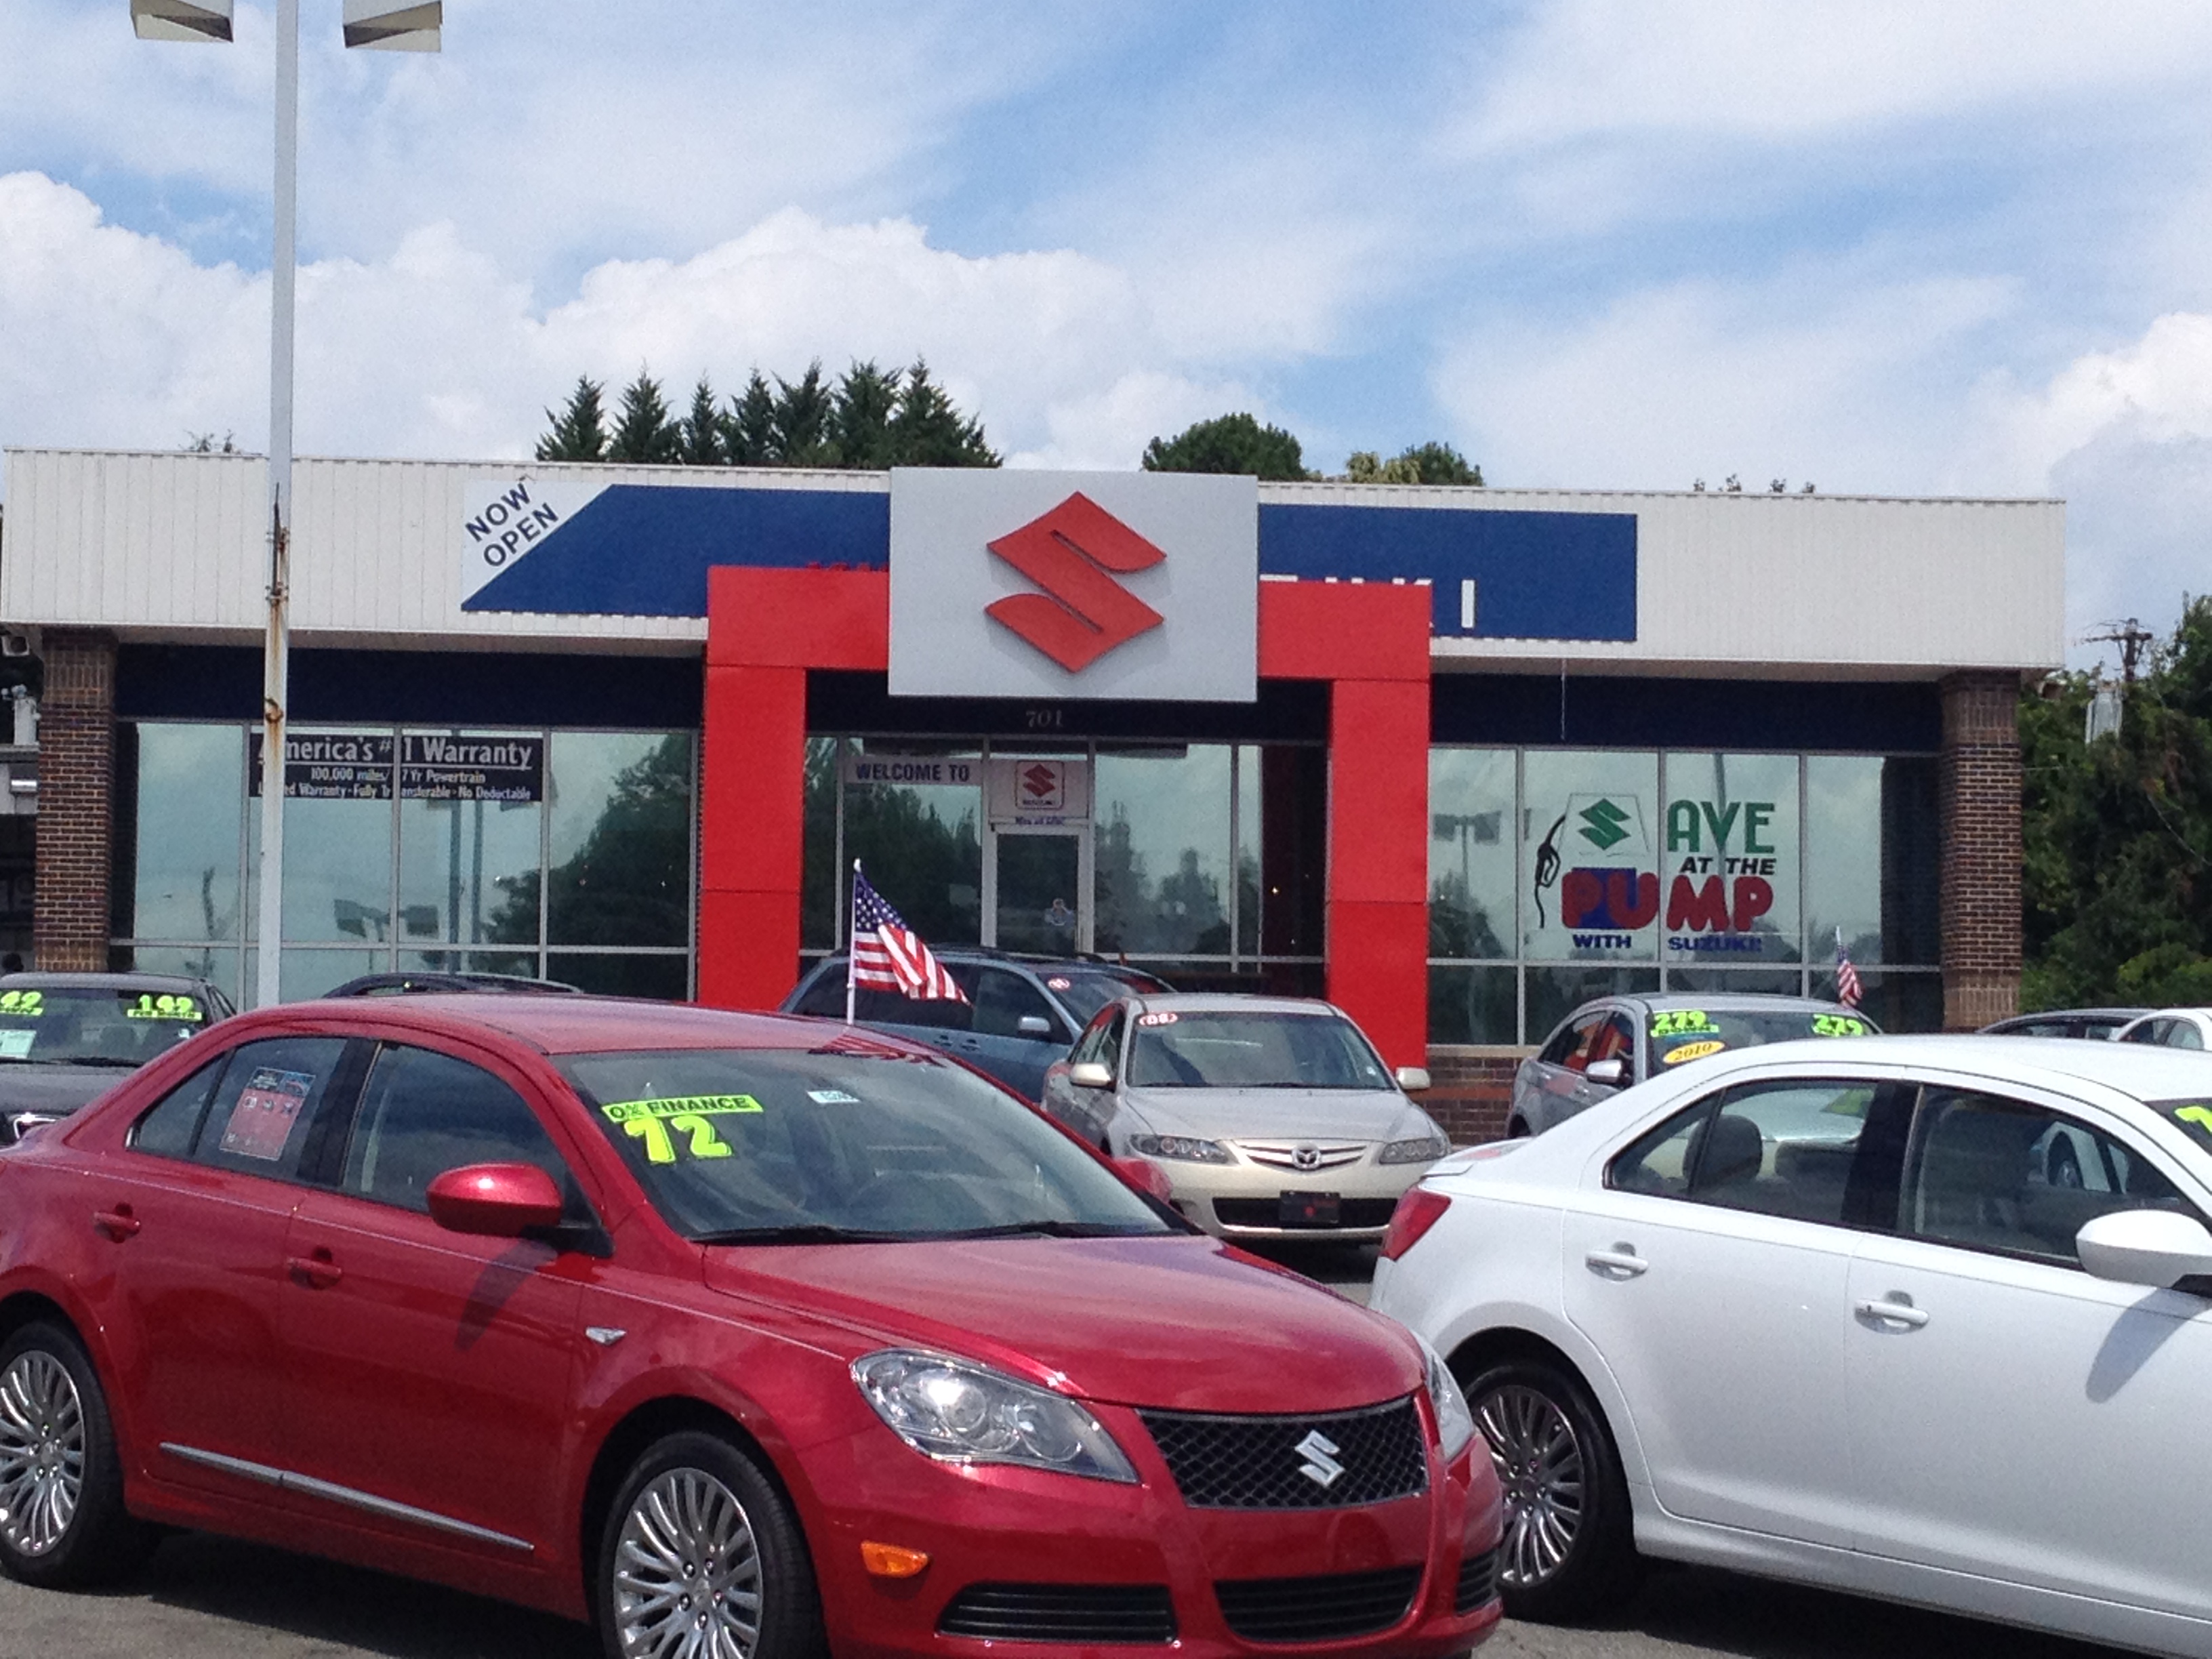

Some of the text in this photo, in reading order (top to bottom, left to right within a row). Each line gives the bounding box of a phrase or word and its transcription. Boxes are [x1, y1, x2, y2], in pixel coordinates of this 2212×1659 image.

[465, 483, 531, 542] NOW
[483, 503, 558, 567] OPEN
[1026, 710, 1063, 727] 701
[423, 737, 533, 771] Warranty
[426, 769, 487, 783] Powertrain
[855, 763, 970, 781] WELCOME TO
[1679, 857, 1777, 875] AT THE
[1561, 872, 1774, 932] PUMP
[1572, 934, 1632, 949] WITH
[1655, 1010, 1706, 1031] 279
[1675, 1043, 1713, 1061] 2010
[609, 1097, 750, 1118] 0% FINANCE
[624, 1114, 733, 1162] 72
